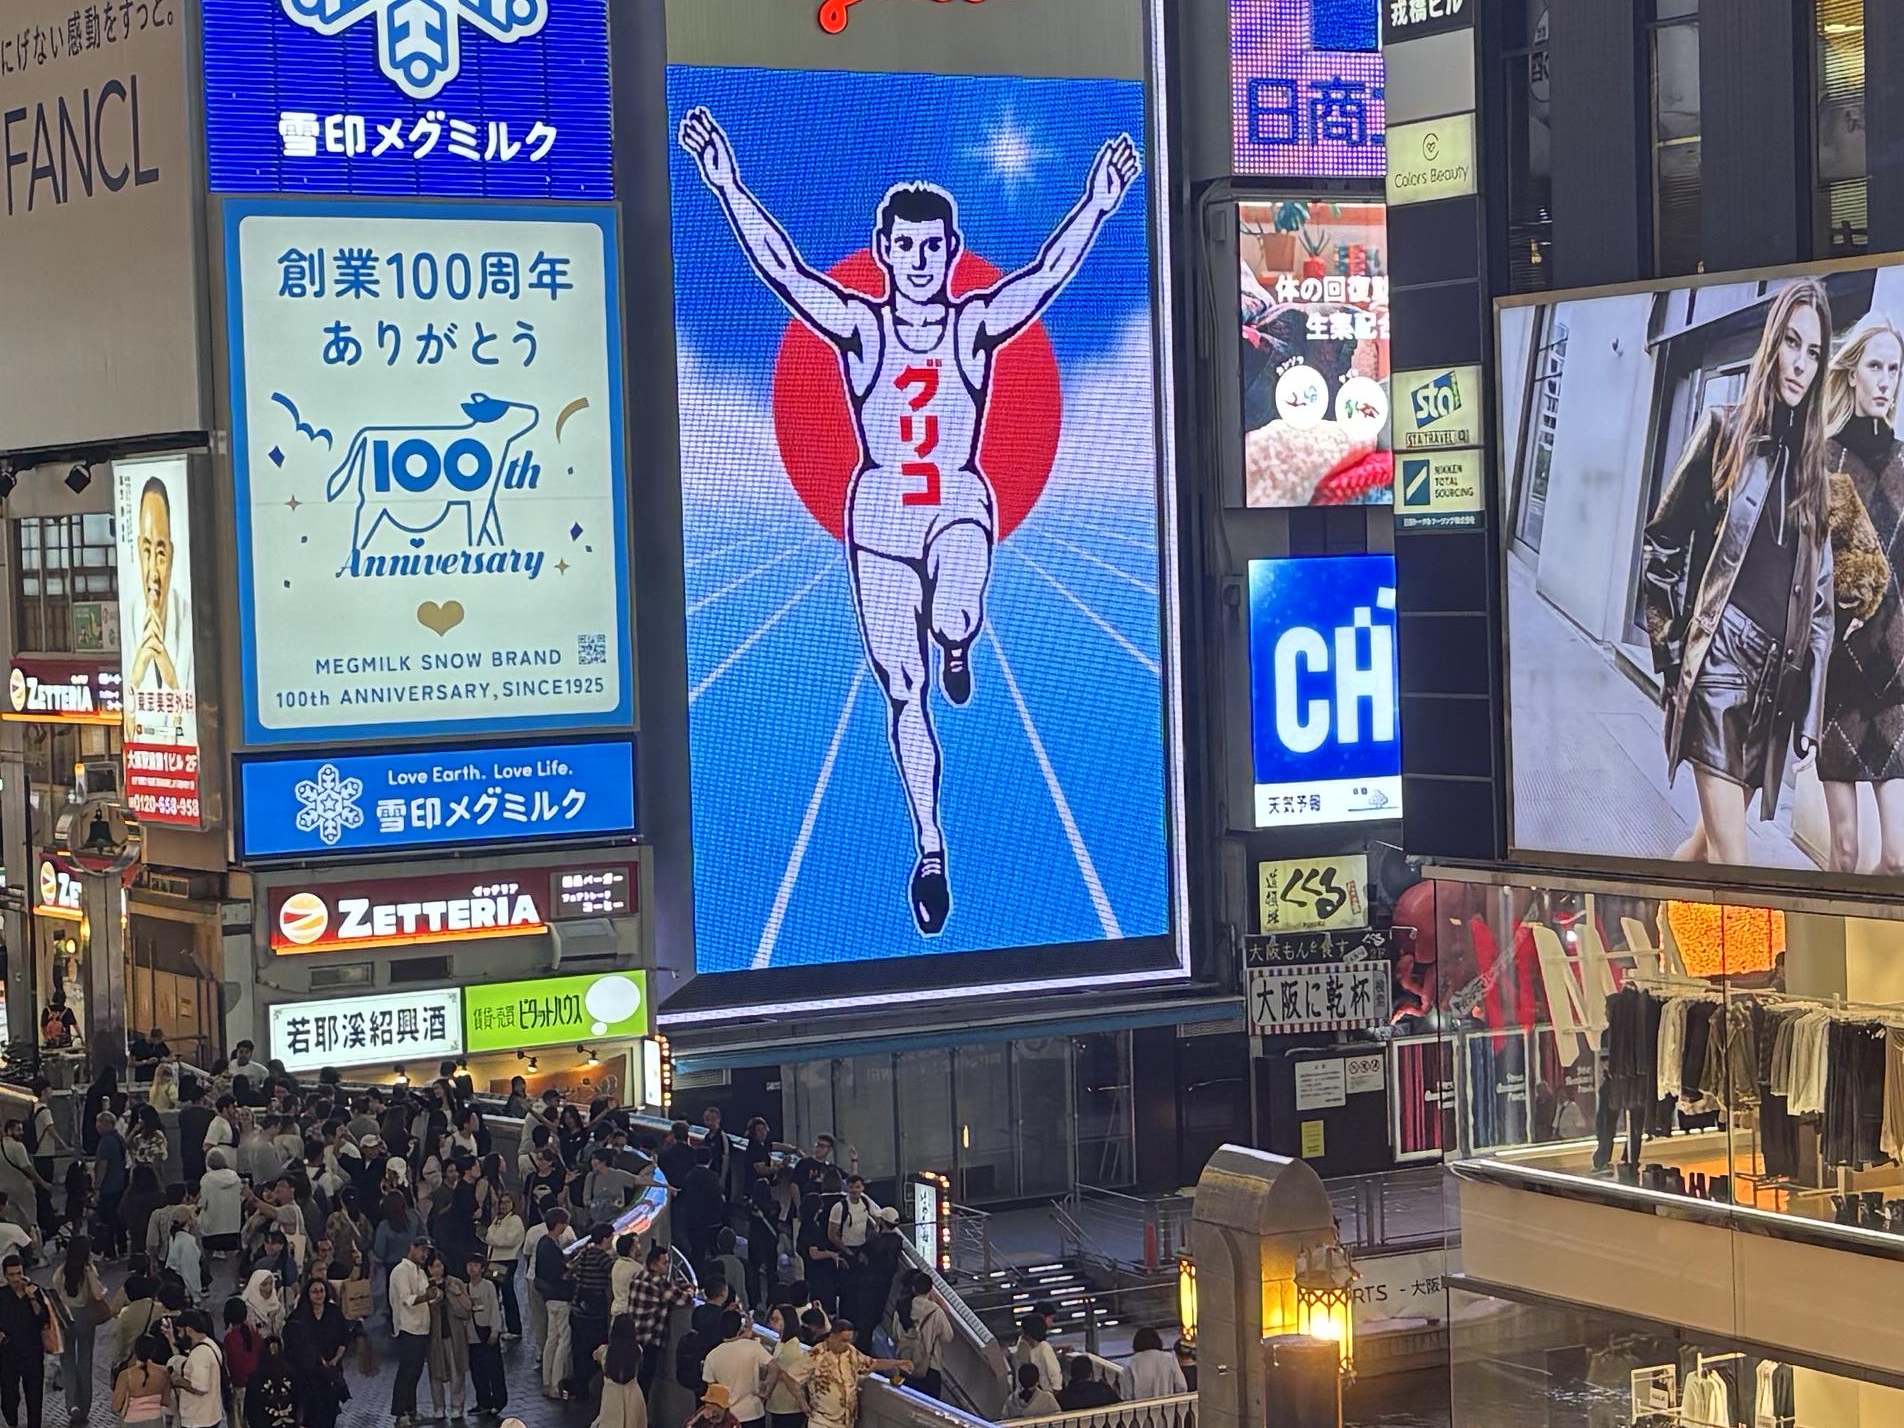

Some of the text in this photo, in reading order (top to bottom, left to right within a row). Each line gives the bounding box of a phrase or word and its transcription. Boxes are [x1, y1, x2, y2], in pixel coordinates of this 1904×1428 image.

[277, 109, 558, 164] 雪印メグミルク
[1246, 74, 1385, 150] 日商
[4, 74, 160, 217] FANCL
[277, 246, 575, 302] 創業100周年
[322, 320, 540, 367] ありがとう
[891, 356, 944, 509] グリコ
[335, 546, 545, 580] Anniversary
[315, 648, 563, 677] MEGMILK SNOW BRAND
[276, 689, 330, 710] 100th
[387, 760, 573, 786] Love Earth. Love Life.
[375, 786, 587, 833] 雪印メグミルク
[1279, 866, 1348, 920] くくる
[1256, 973, 1371, 1023] 大阪に乾杯
